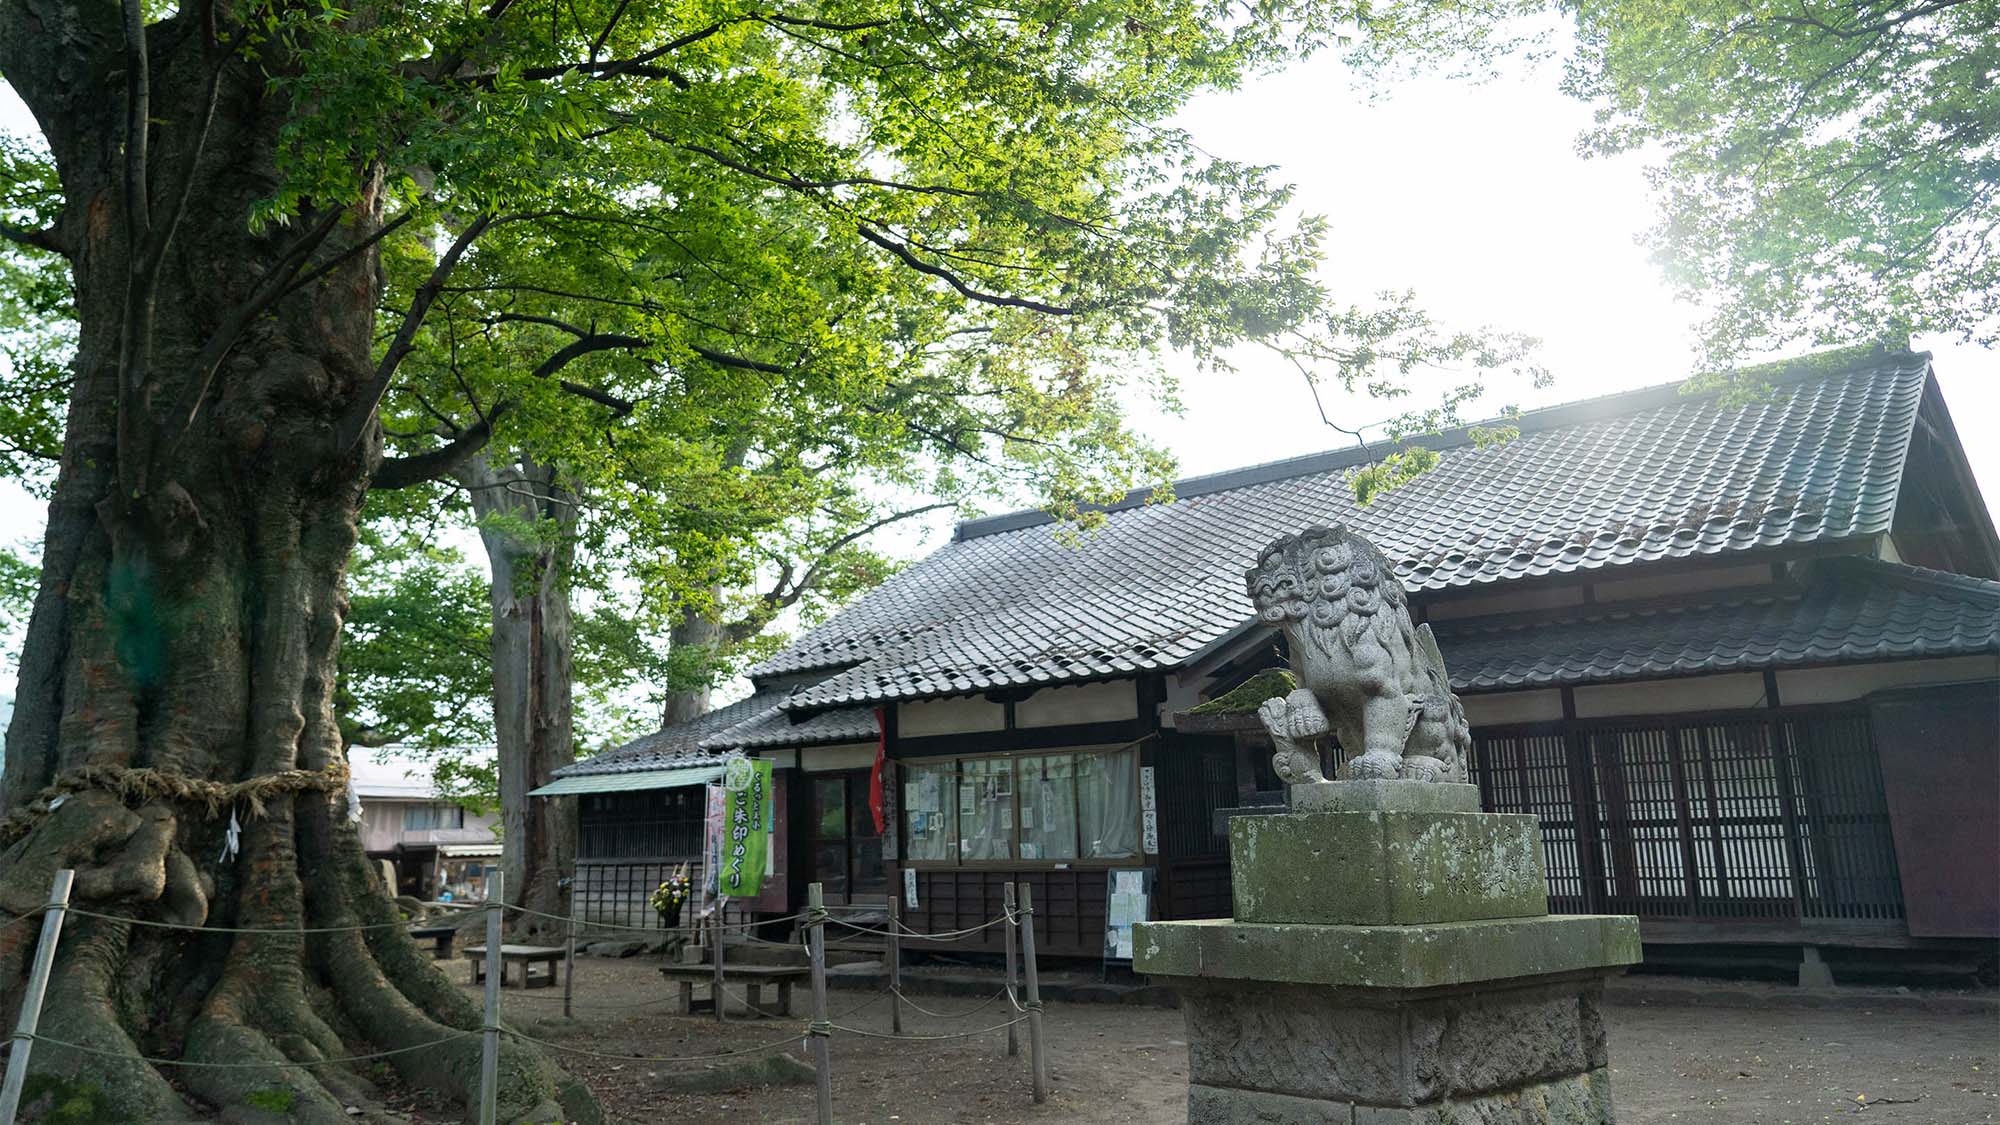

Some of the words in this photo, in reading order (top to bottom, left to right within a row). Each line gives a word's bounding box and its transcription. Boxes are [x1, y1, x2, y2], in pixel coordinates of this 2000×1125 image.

[729, 792, 750, 889] ご朱印めぐり
